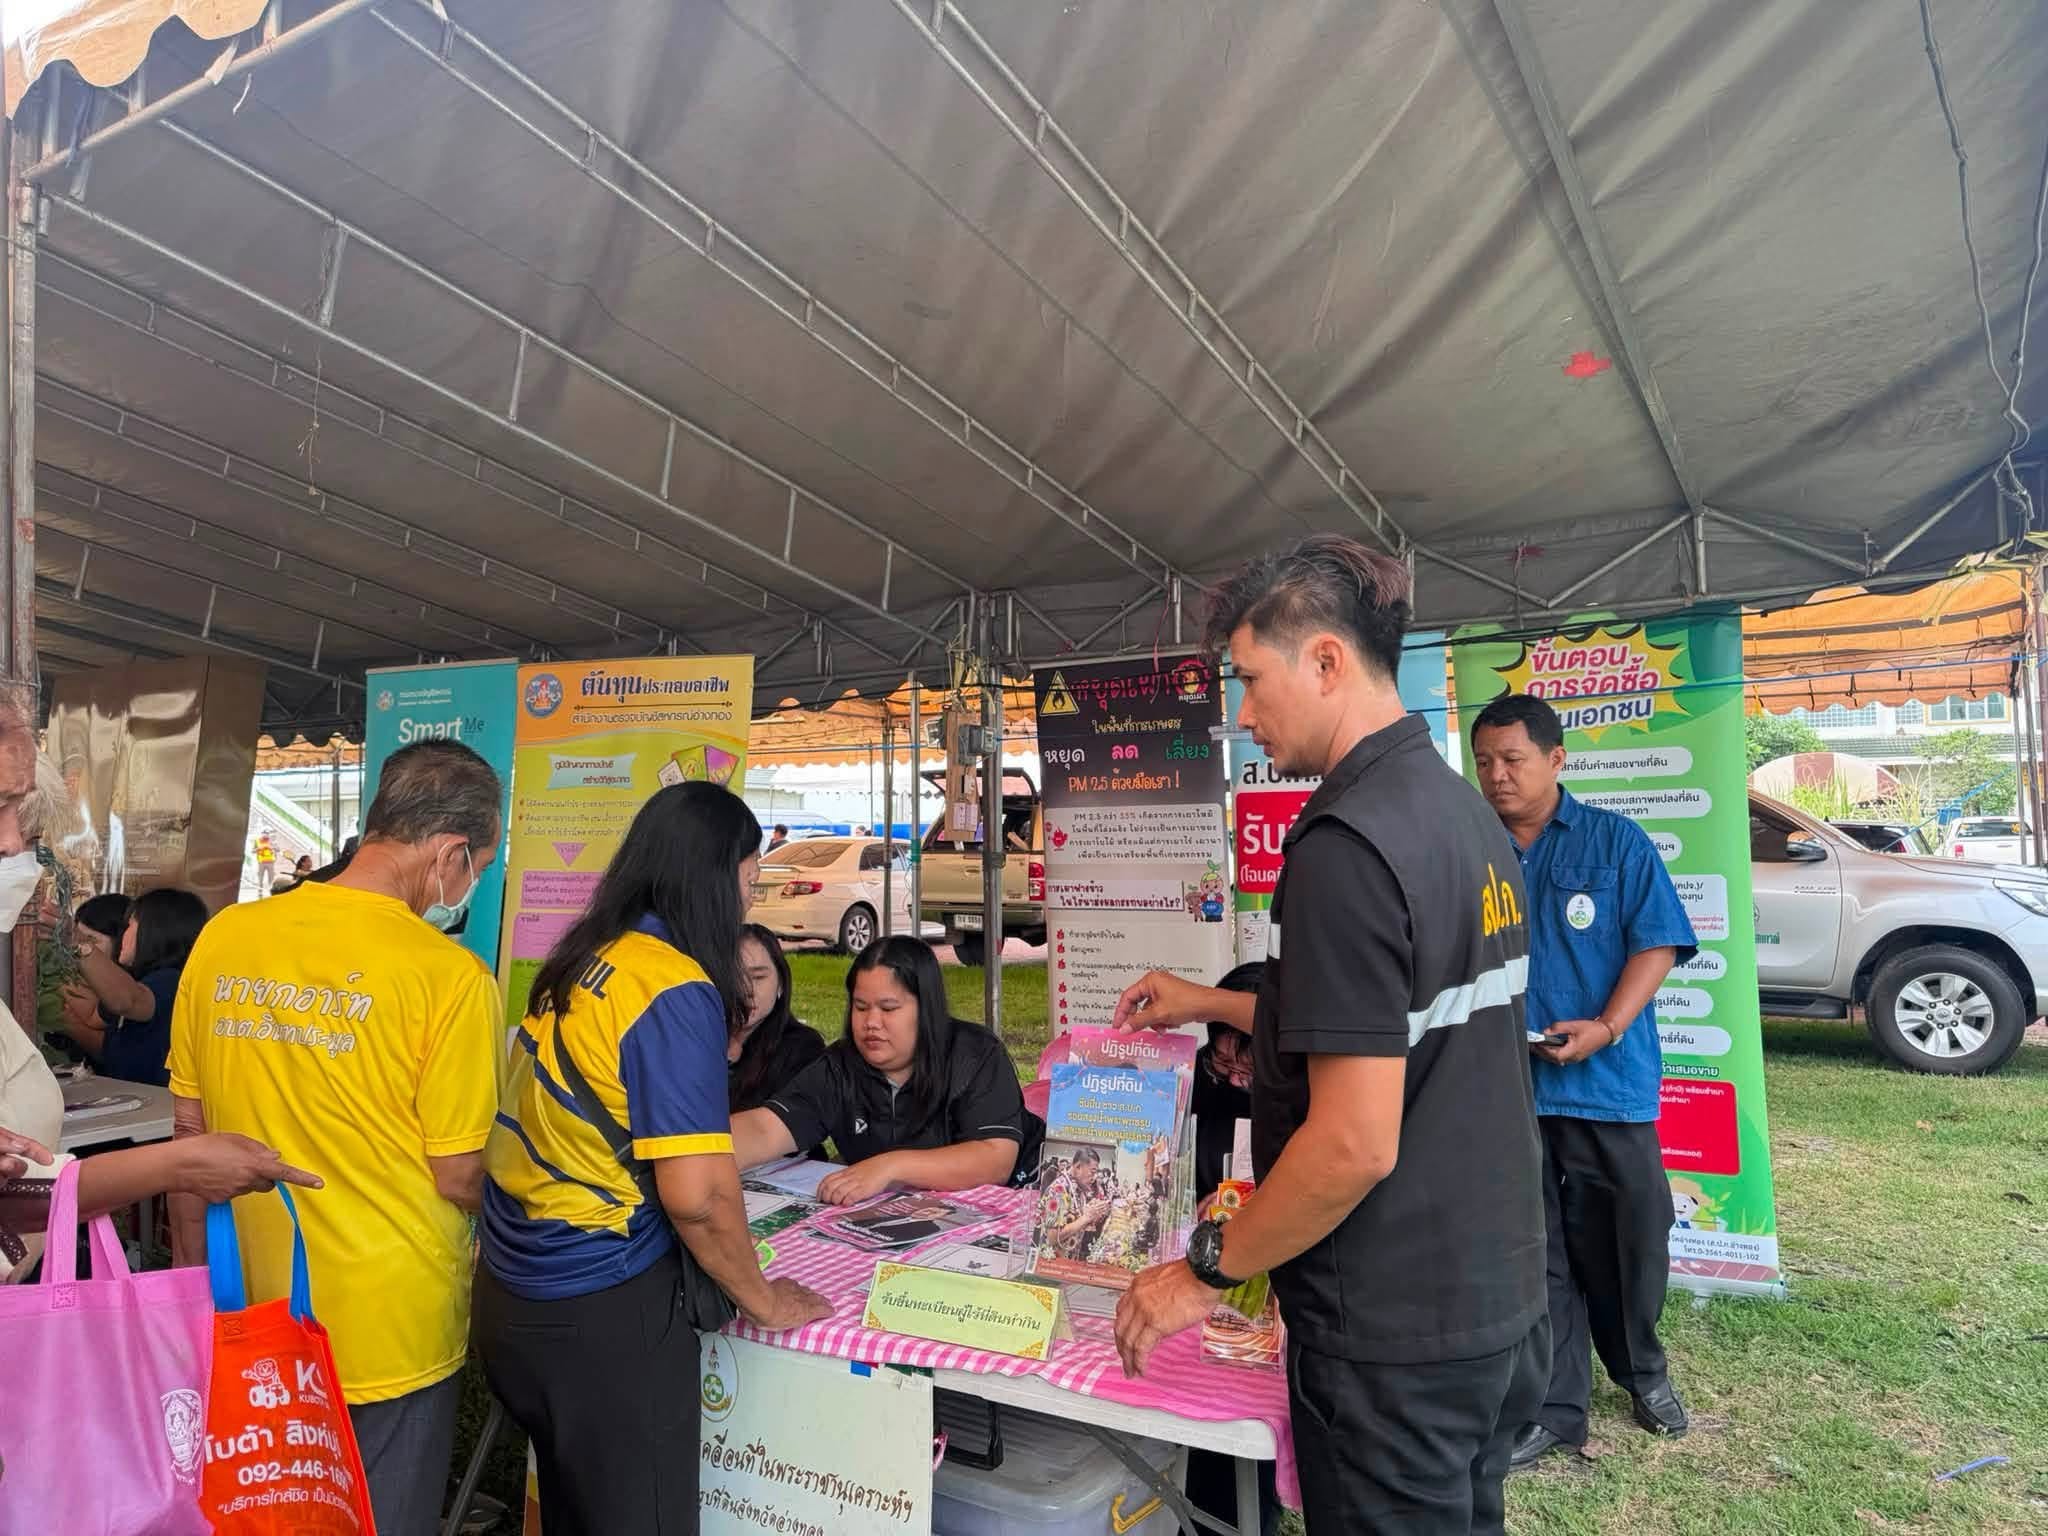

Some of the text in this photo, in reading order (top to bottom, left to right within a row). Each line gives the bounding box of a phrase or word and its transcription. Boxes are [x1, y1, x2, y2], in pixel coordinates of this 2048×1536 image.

[1531, 637, 1629, 673] ขั้นตอน
[1527, 656, 1659, 700] การจัดซื้อ
[398, 716, 485, 743] Smart Me
[1559, 698, 1652, 730] นเอกชน
[1044, 733, 1209, 770] หยุด ลด เลี่ยง
[1068, 776, 1088, 792] PM
[1240, 864, 1281, 885] (โฉนด
[213, 970, 374, 1023] นายกอาร์ท
[1101, 1037, 1160, 1060] ปฏิรูปที่ดิน
[1082, 1070, 1143, 1094] ปฏิรูปที่ดิน
[700, 1430, 913, 1523] คลื่อนที่ในพระราชานุเคราะห์ฯ
[699, 1485, 825, 1536] รูปที่ดินจังหวัดอ่างทอง
